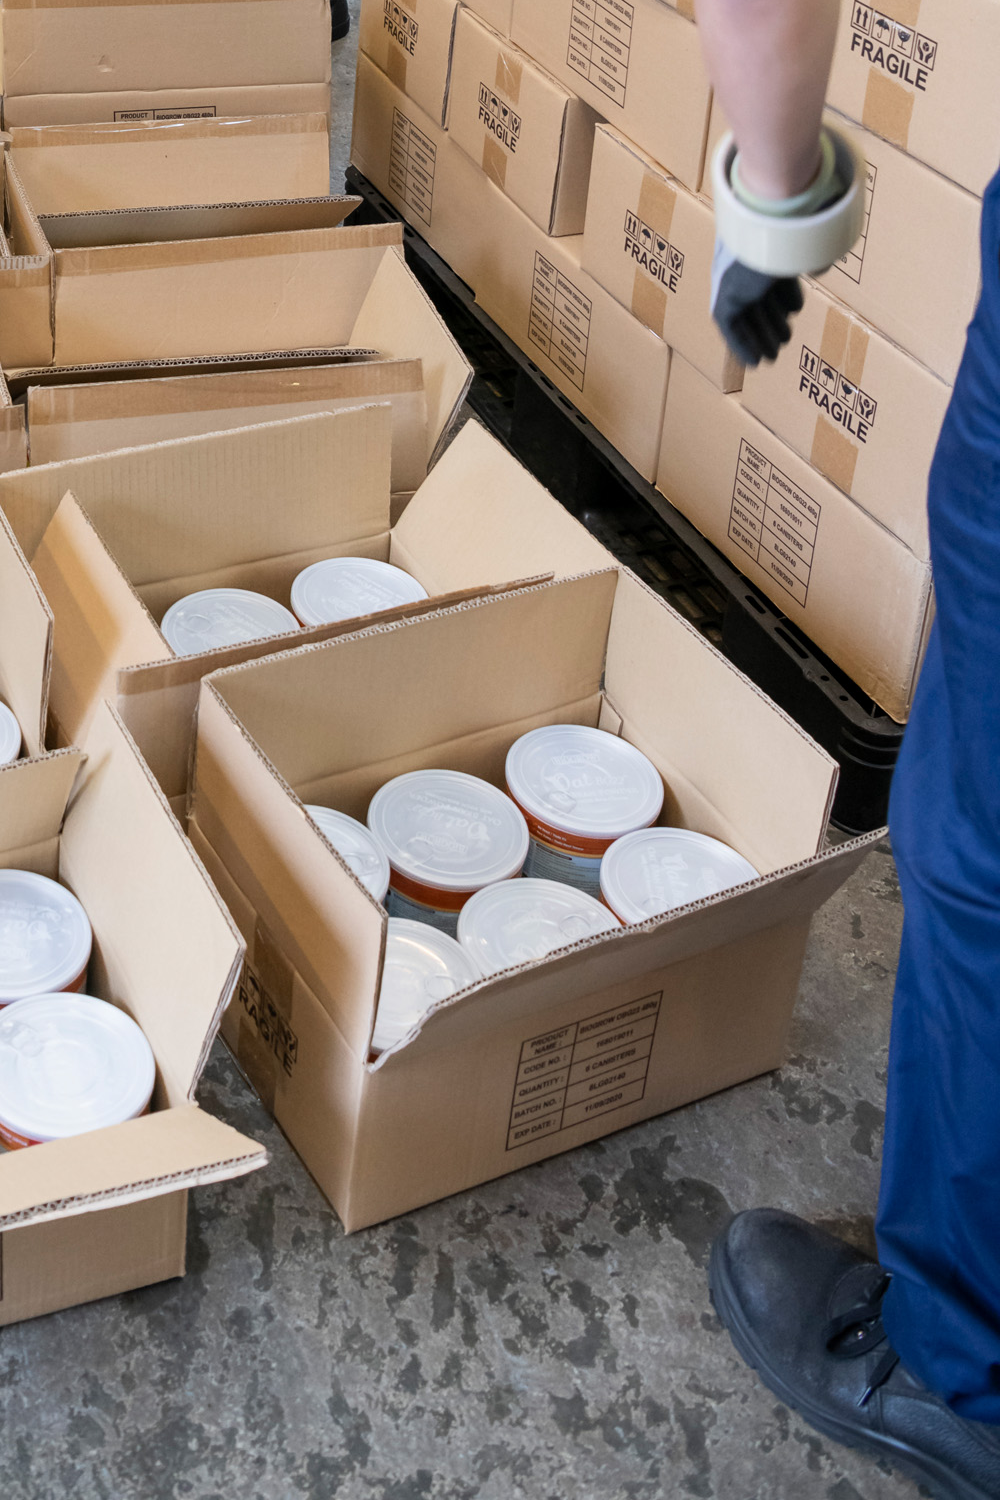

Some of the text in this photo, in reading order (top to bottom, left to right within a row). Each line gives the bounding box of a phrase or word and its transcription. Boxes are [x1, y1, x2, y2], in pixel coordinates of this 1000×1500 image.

[384, 16, 415, 57] FRAGILE
[851, 32, 928, 92] FRAGILE
[479, 106, 516, 154] FRAGILE
[624, 236, 677, 293] FRAGILE
[799, 375, 869, 443] FRAGILE
[745, 445, 767, 469] PRODUCT
[747, 456, 760, 472] NAME
[740, 468, 753, 484] CODE
[753, 479, 762, 492] NO.
[772, 473, 792, 496] BIOGROW
[737, 486, 759, 512] QUANTITY
[733, 505, 749, 524] BATCH
[749, 519, 757, 532] NO.
[732, 526, 741, 539] EXP
[741, 534, 753, 550] DATE
[773, 519, 803, 552] 6 CANISTERS
[239, 990, 292, 1077] RAGILE
[579, 1015, 615, 1034] BIOGROW
[530, 1028, 569, 1049] PRODUCT
[534, 1041, 557, 1056] NAME
[524, 1061, 546, 1075] CODE
[548, 1055, 562, 1066] NO.
[585, 1047, 637, 1073] 6 CANISTERS
[518, 1076, 560, 1098] QUANTITY
[514, 1103, 542, 1119] BATCH
[543, 1097, 558, 1109] NO.
[514, 1128, 530, 1140] EXP
[531, 1119, 553, 1133] DATE
